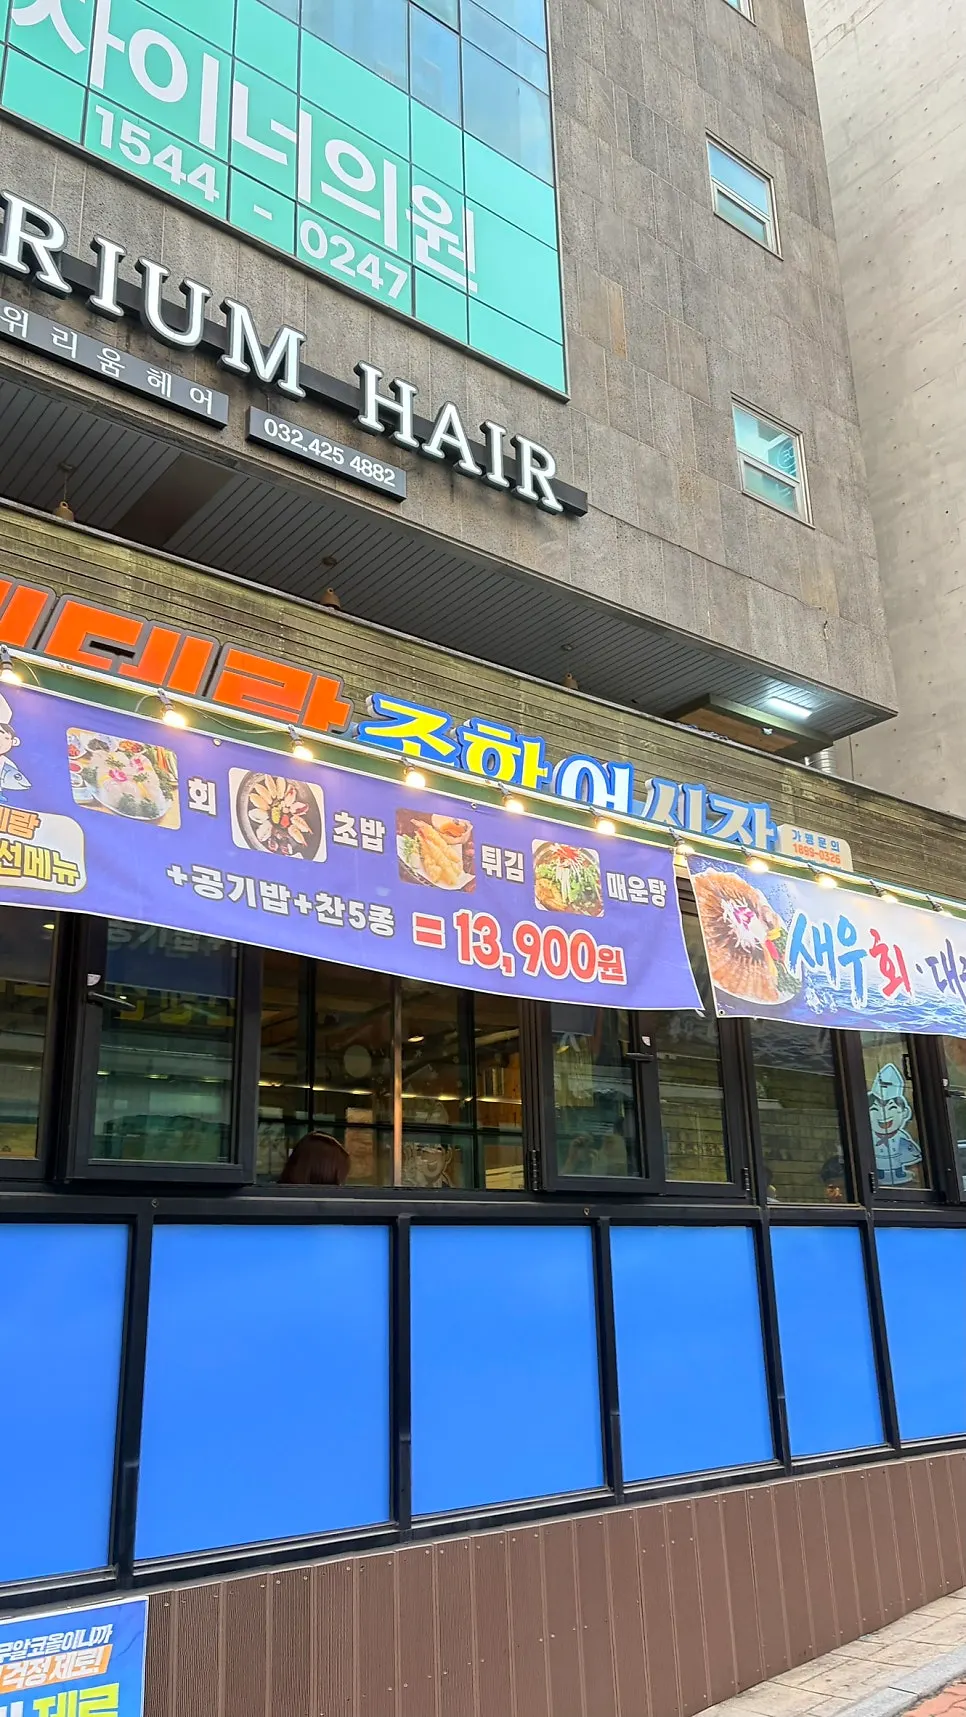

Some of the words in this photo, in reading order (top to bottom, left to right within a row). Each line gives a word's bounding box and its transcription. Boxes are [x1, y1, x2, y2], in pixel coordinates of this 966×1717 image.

[95, 105, 220, 203] 1544
[300, 221, 409, 300] 0247
[0, 189, 307, 398] RIUM
[355, 360, 564, 513] HAIR
[264, 418, 345, 465] 032.425
[350, 455, 396, 487] 4882
[187, 776, 217, 816] 회
[332, 811, 386, 852] 초밥
[481, 844, 525, 883] 튀김
[606, 872, 668, 907] 매운탕
